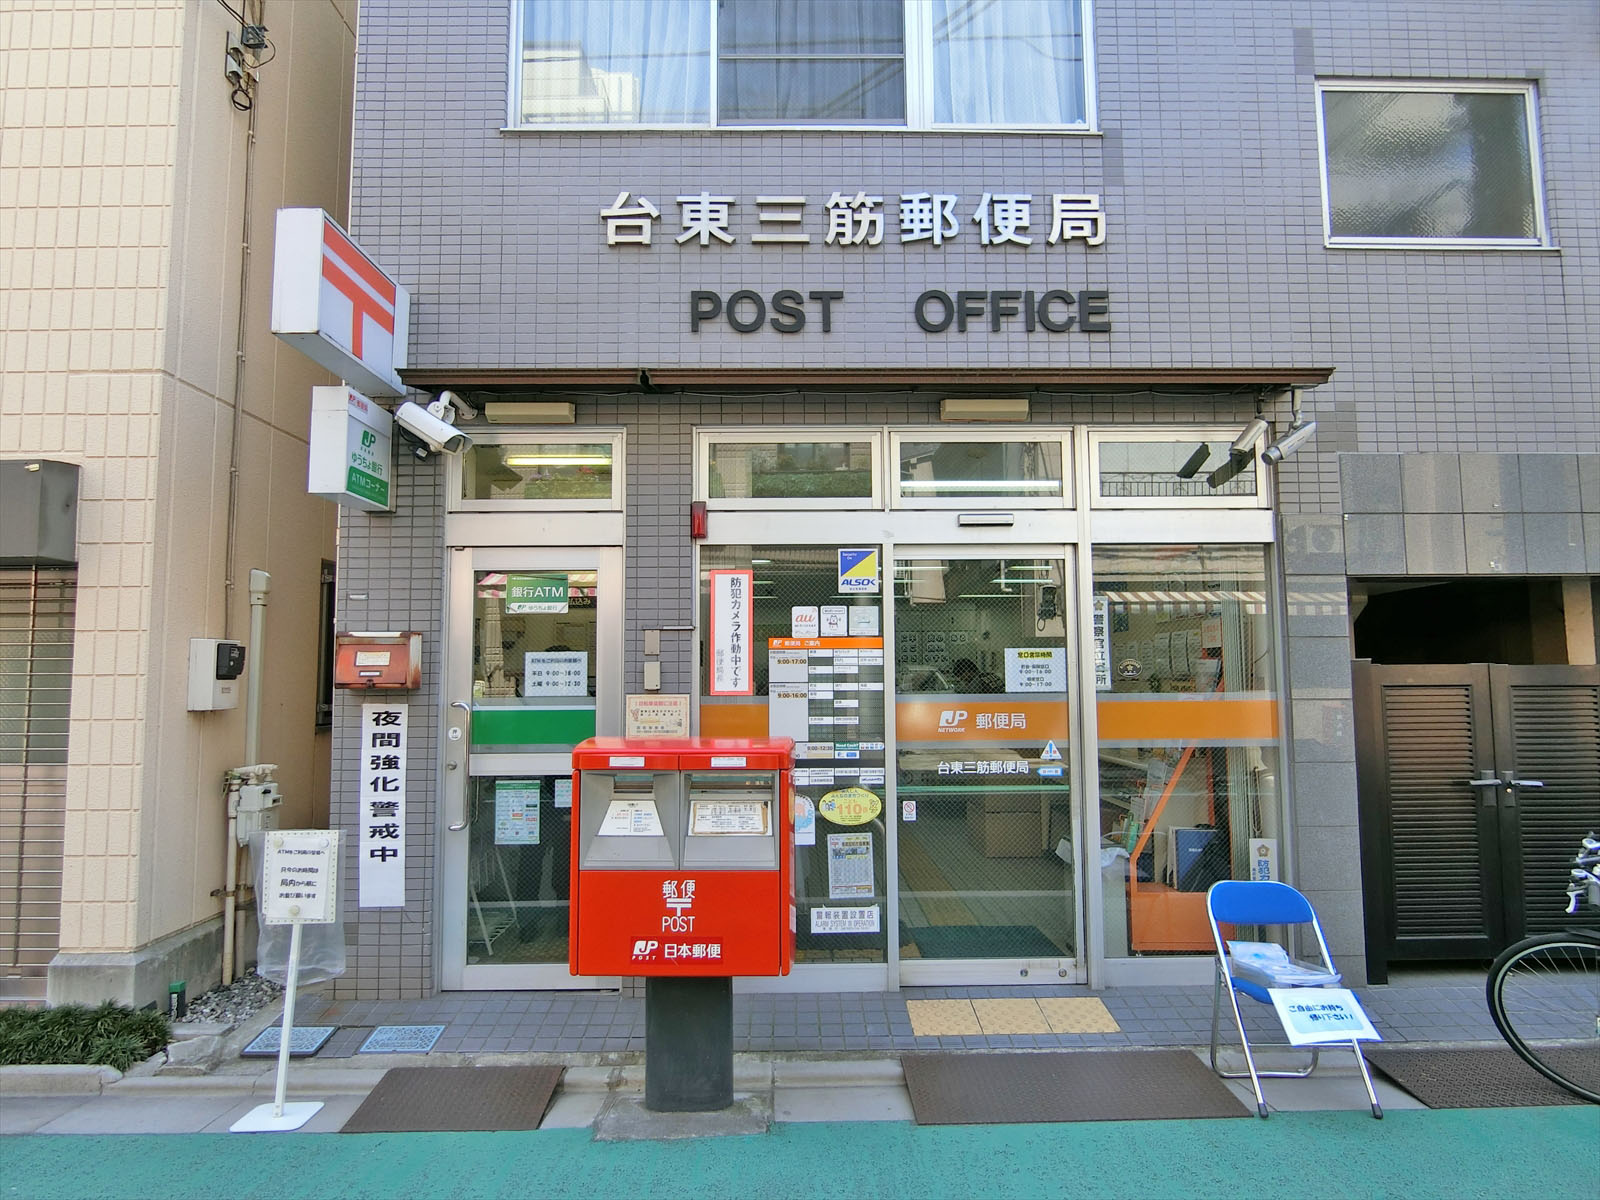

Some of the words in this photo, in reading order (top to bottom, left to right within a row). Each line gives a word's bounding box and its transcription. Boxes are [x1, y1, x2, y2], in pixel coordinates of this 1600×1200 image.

[600, 191, 1107, 248] 台東三筋郵便局
[690, 290, 844, 333] POST
[914, 290, 1112, 333] OFFICE
[351, 451, 383, 476] ゆうちょ銀行
[351, 472, 385, 492] ATMコーナー
[841, 578, 876, 586] ALSOK
[511, 586, 564, 598] 銀行ATM
[795, 614, 815, 623] au
[730, 577, 742, 688] 防犯カメラ作動中です
[975, 712, 1027, 730] 郵便局
[937, 760, 1030, 775] 台東三筋郵便局
[368, 710, 403, 863] 夜間強化警戒中
[662, 879, 696, 899] 郵便
[662, 916, 696, 933] POST
[664, 943, 721, 959] 日本郵便
